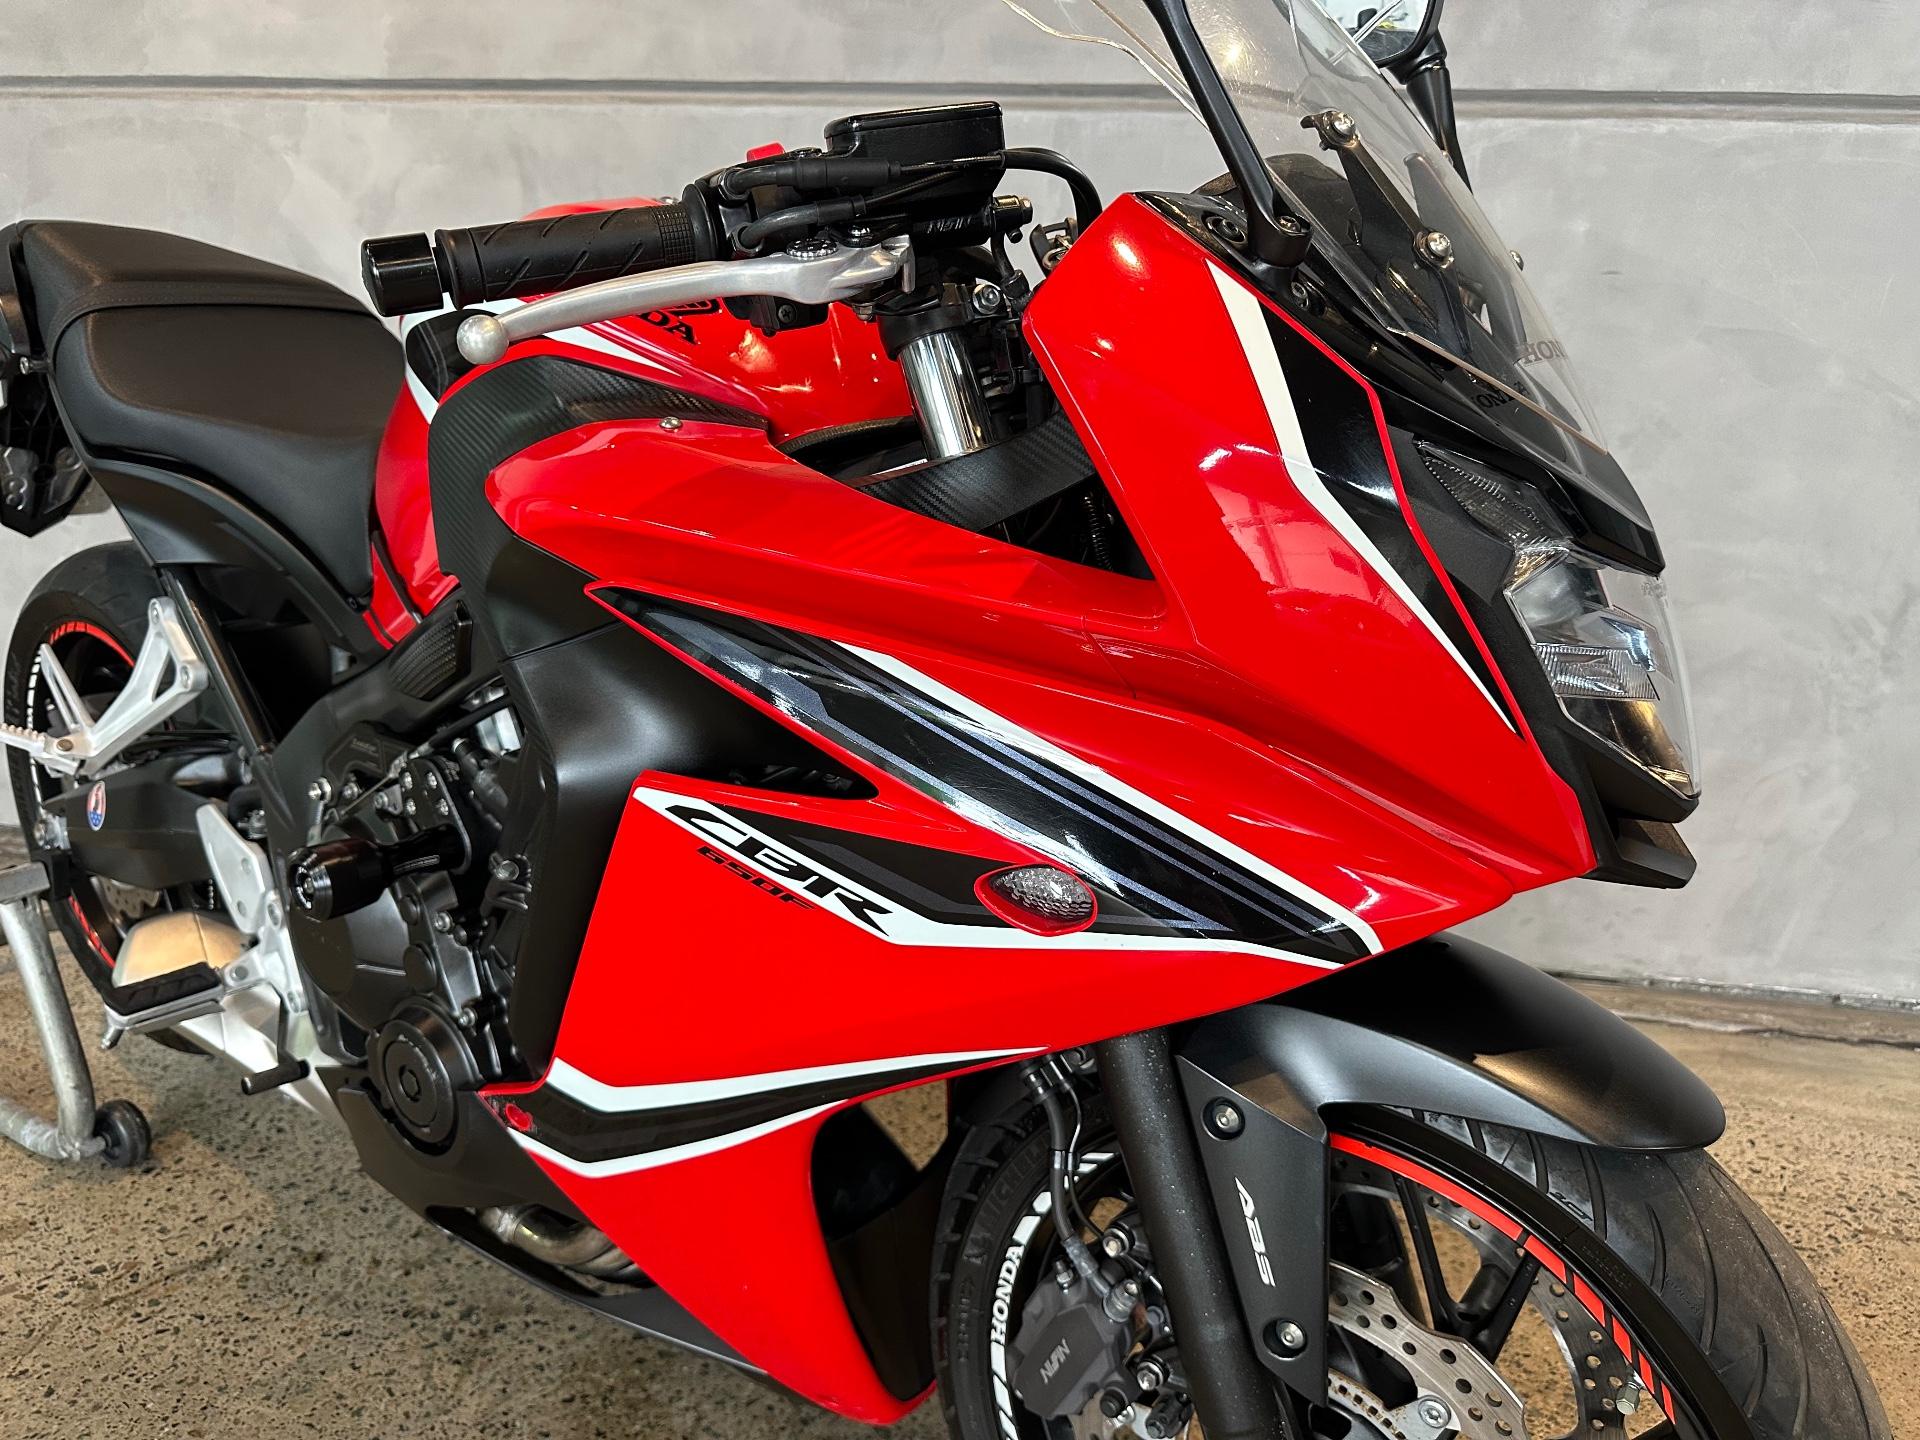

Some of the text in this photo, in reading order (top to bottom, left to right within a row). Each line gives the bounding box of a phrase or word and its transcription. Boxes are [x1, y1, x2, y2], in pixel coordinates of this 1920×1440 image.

[664, 804, 894, 937] CBR
[696, 846, 816, 911] 650F
[1234, 1176, 1277, 1288] ABS
[990, 1244, 1025, 1345] HONDA
